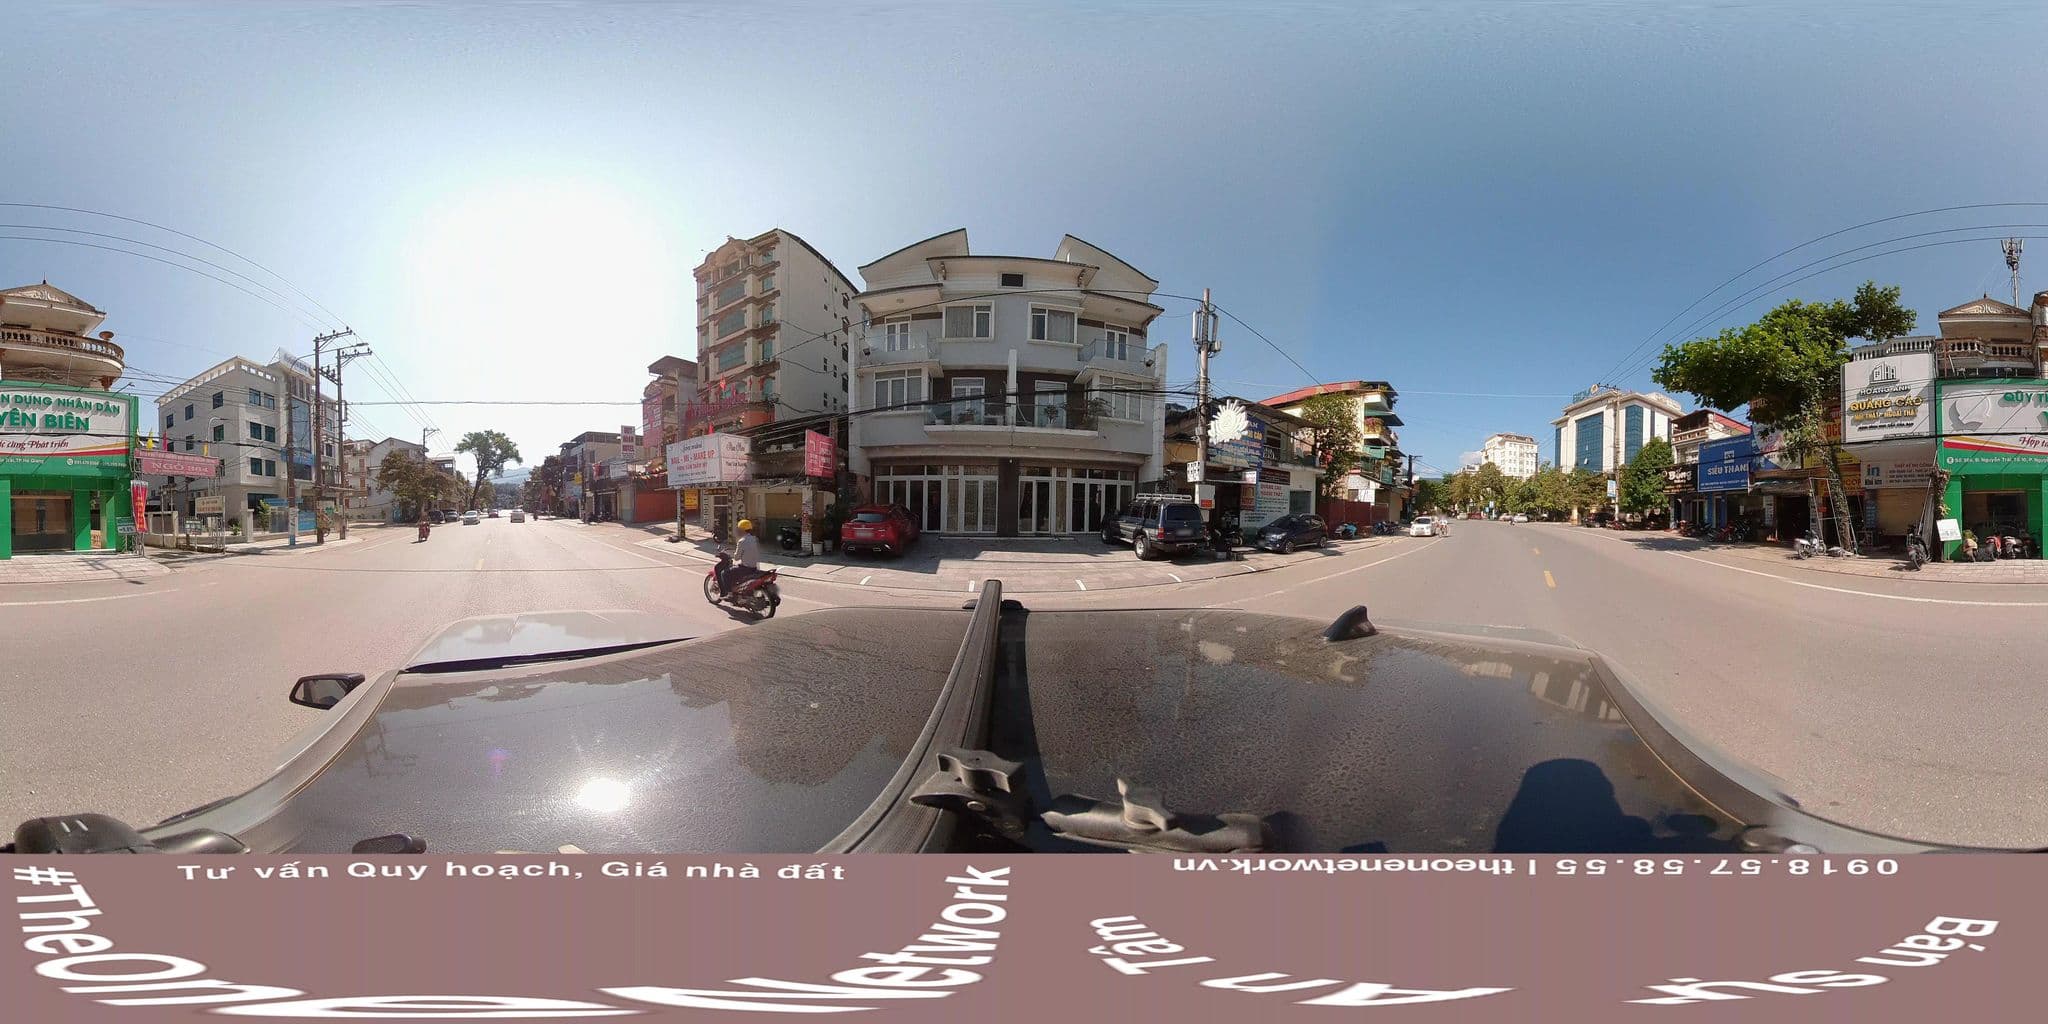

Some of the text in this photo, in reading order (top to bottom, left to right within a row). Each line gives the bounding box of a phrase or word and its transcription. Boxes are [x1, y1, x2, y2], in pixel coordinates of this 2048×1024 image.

[14, 394, 53, 407] DỤNG
[57, 397, 92, 410] NHÂN
[96, 402, 120, 414] DÂN
[1850, 394, 1923, 411] QUẢNG CÁO
[2003, 390, 2033, 403] QUỸ
[45, 412, 90, 432] BIÊN
